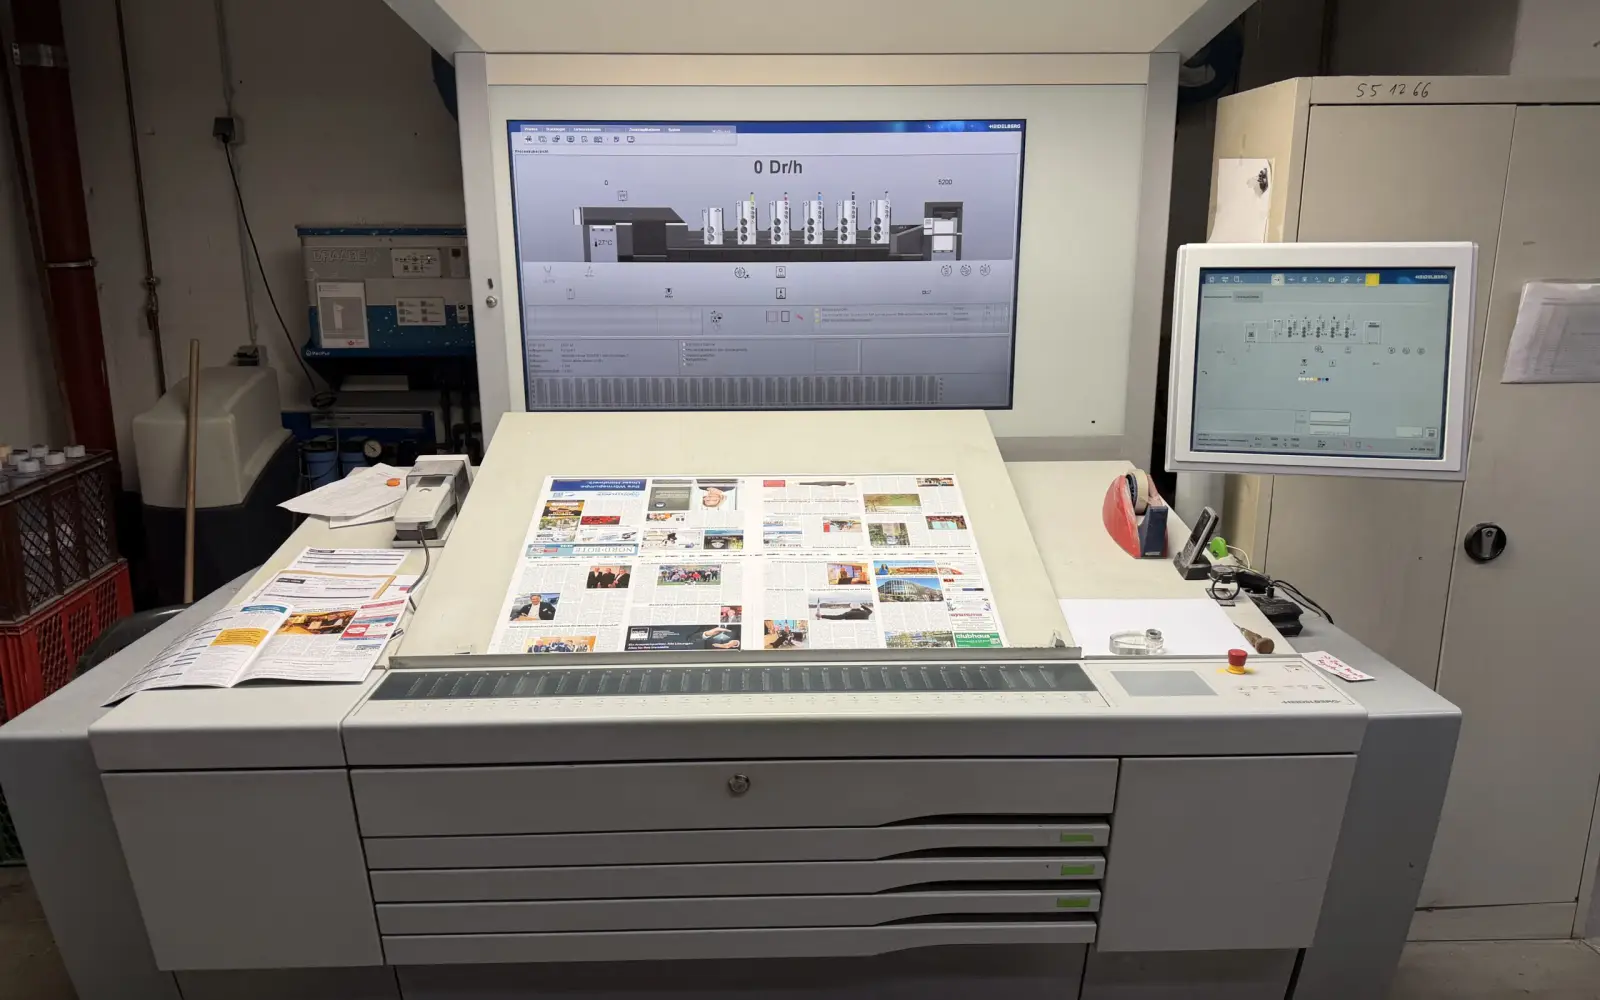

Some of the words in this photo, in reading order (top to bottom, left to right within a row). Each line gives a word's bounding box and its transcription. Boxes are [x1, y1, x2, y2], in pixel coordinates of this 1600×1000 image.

[1389, 83, 1406, 95] 12
[1412, 81, 1431, 98] 66
[753, 160, 763, 174] 0
[769, 159, 803, 175] Dr/h
